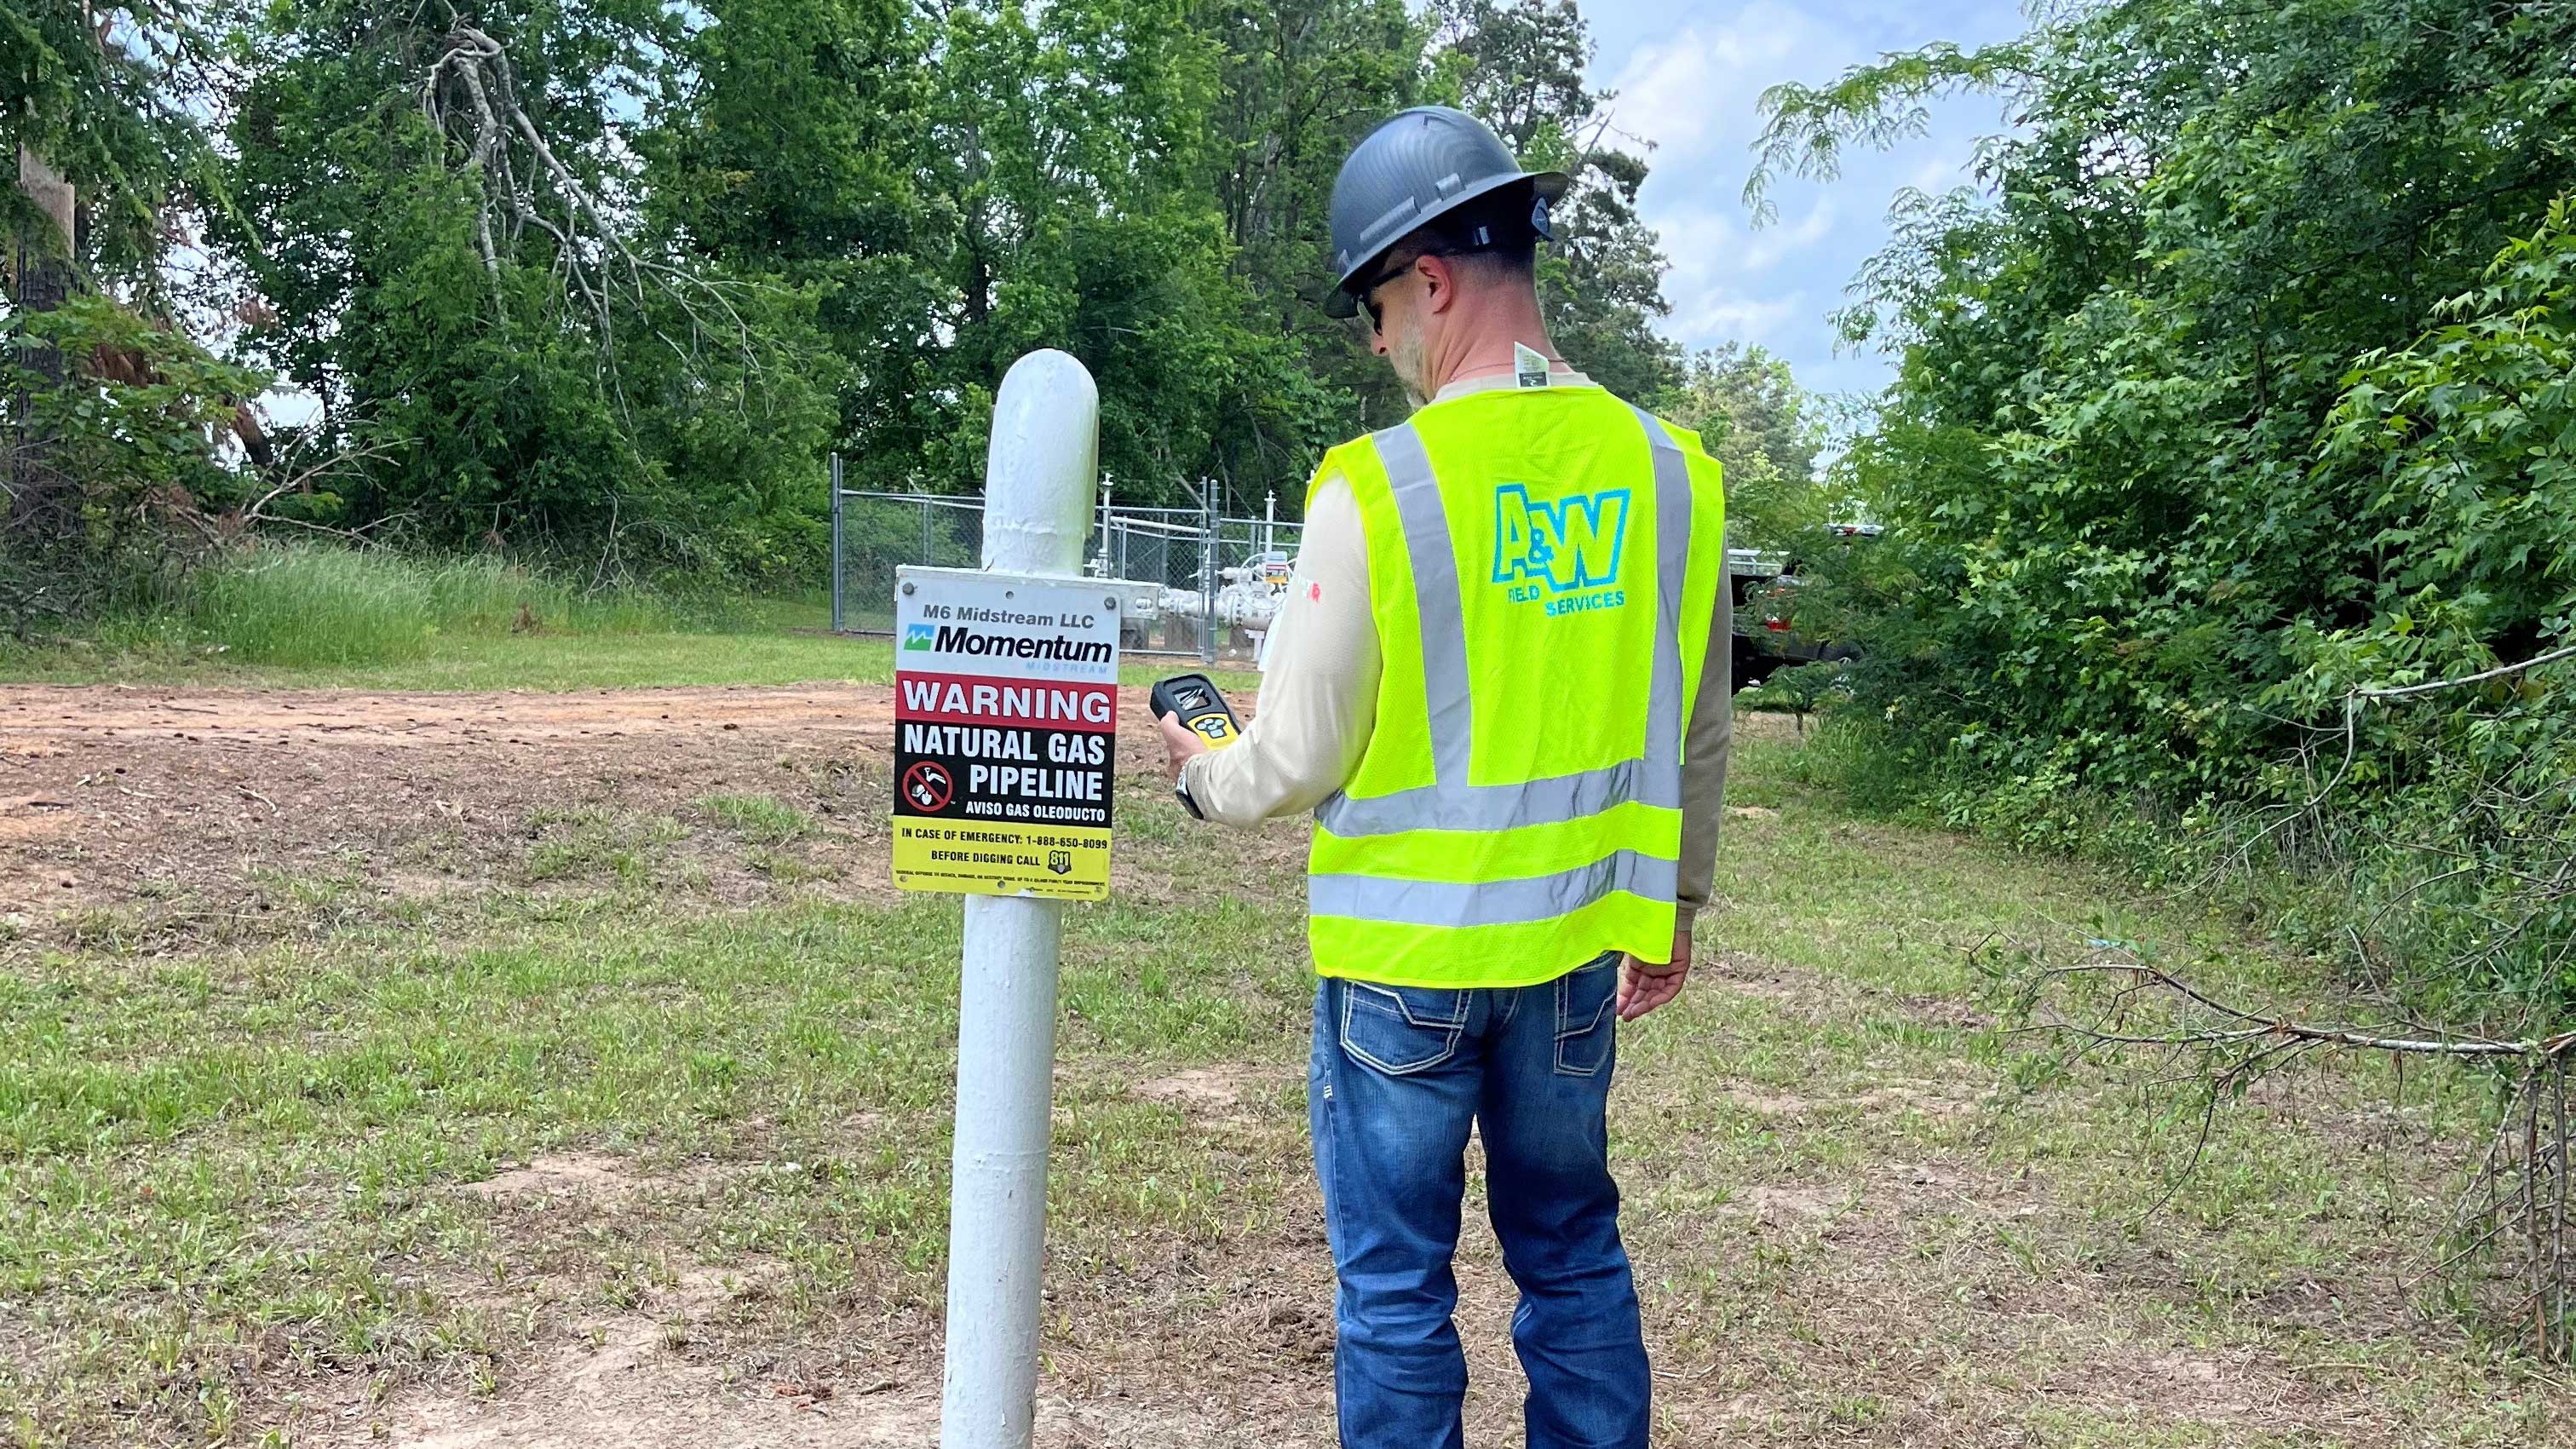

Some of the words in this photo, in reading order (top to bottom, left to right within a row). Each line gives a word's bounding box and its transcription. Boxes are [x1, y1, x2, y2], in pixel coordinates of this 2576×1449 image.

[1492, 483, 1631, 593] A&W
[923, 604, 951, 619] M6
[957, 607, 1054, 627] Midstream
[1060, 613, 1095, 629] LLC
[1545, 590, 1625, 617] SERVICES
[934, 625, 1113, 663] Momentum
[1026, 662, 1107, 674] MIDSTREAM
[902, 680, 1111, 723] WARNING
[904, 724, 1038, 761] NATURAL
[1048, 733, 1106, 765] GAS
[969, 764, 1103, 801] PIPELINE
[965, 801, 1002, 815] AVISO
[1005, 803, 1030, 817] GAS
[1033, 805, 1106, 822] OLEODUCTO
[901, 828, 912, 837] IN
[915, 829, 940, 839] CASE
[944, 830, 957, 840] OF
[960, 831, 1022, 844] EMERGENCY:
[931, 850, 969, 862] BEFORE
[973, 853, 1014, 865] DIGGING
[1016, 854, 1040, 865] CALL
[1049, 851, 1071, 866] 811
